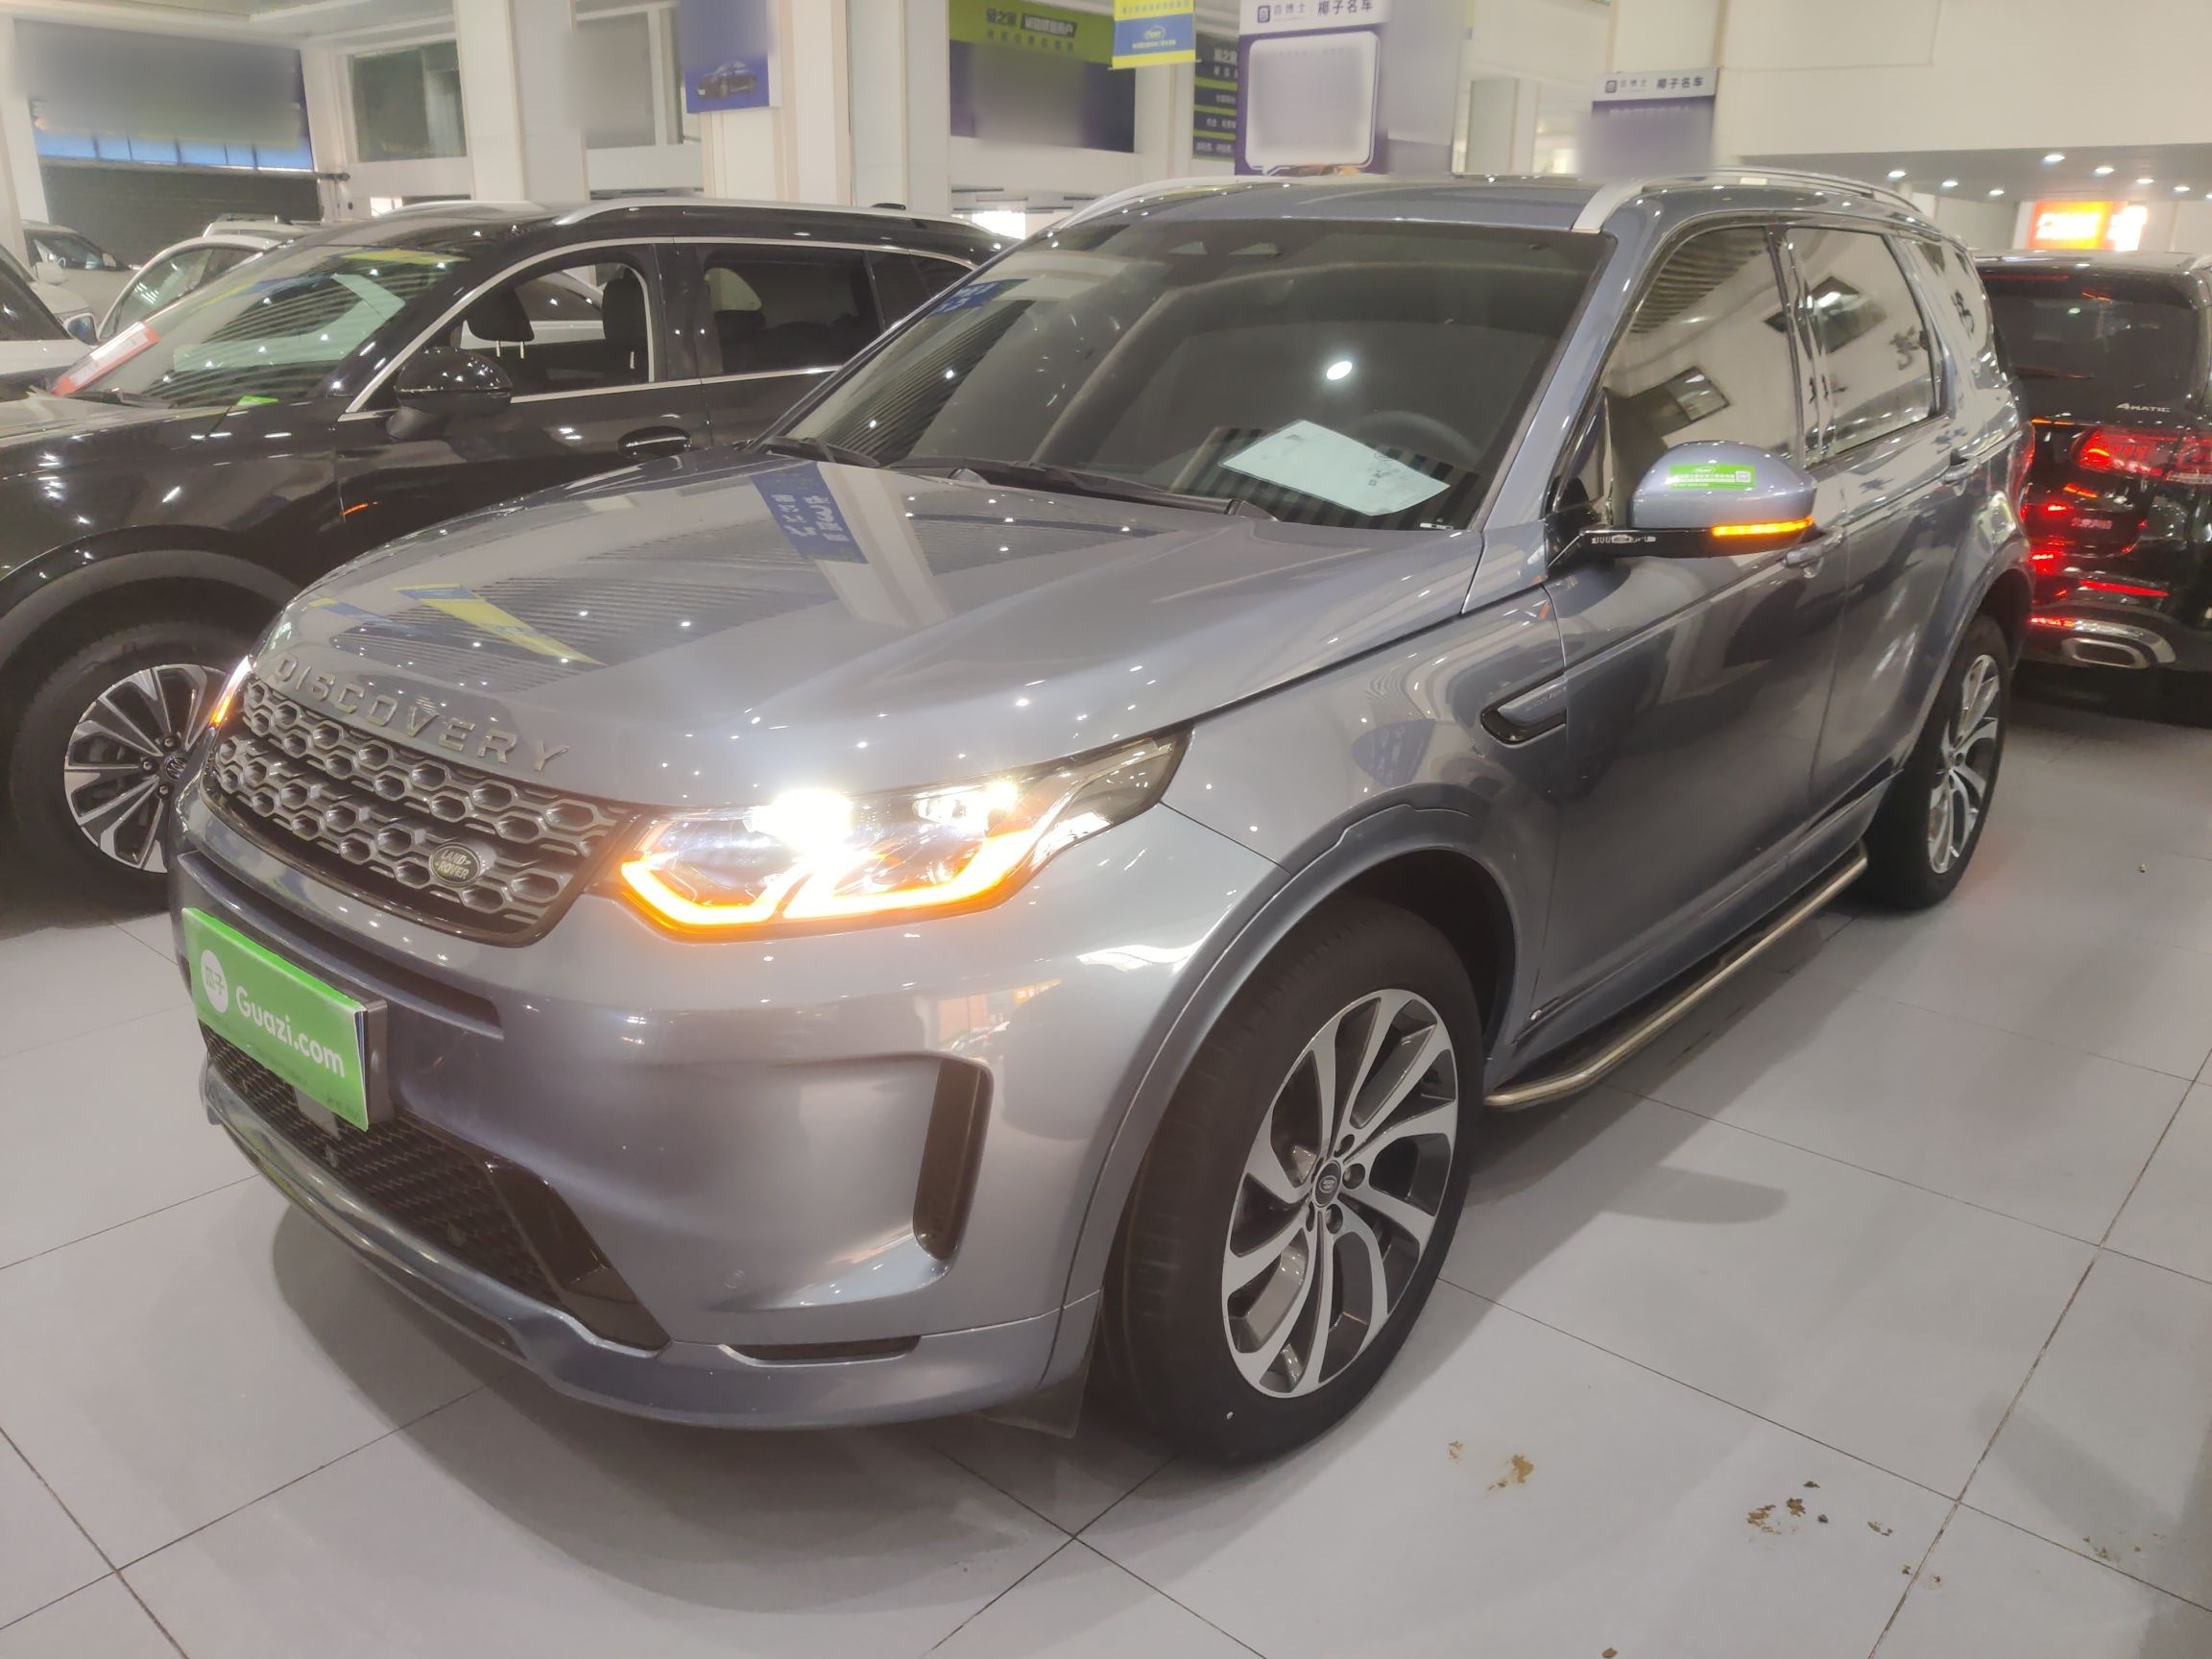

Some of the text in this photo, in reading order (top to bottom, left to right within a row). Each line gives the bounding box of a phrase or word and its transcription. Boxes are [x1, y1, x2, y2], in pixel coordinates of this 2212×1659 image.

[272, 653, 570, 772] DISCOVERY
[437, 860, 469, 880] ROVER
[441, 850, 468, 865] LAND
[204, 965, 225, 996] 瓜子
[235, 985, 346, 1078] Guazi.com
